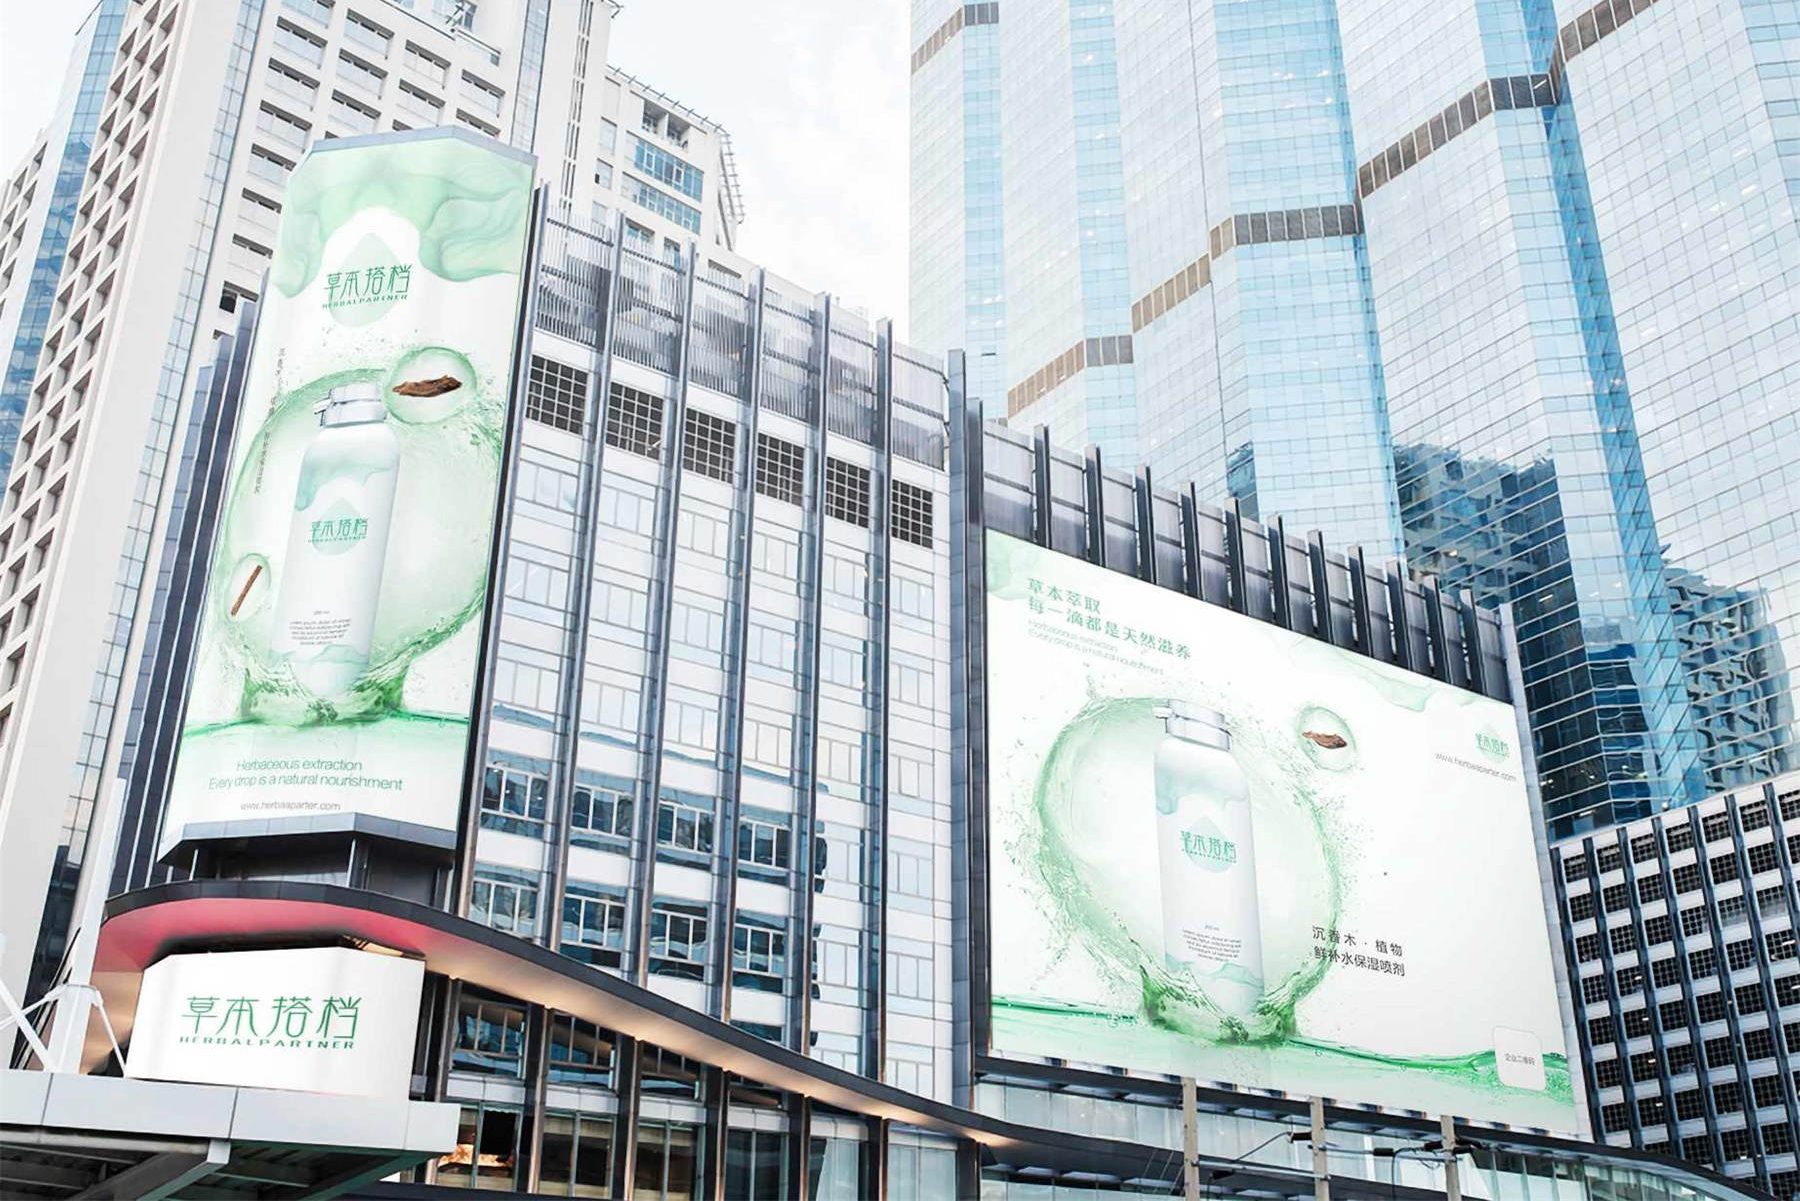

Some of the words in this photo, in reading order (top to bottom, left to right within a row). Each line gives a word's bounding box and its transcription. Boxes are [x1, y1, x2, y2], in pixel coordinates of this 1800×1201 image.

[323, 264, 412, 300] 草本搭档
[1029, 596, 1191, 660] 每一滴都是天然滋养
[302, 759, 362, 771] extraction
[279, 773, 318, 786] natural
[320, 774, 403, 791] nourishment
[1314, 945, 1405, 977] 鲜补水保湿喷剂
[181, 996, 362, 1040] 草本搭档
[179, 1035, 354, 1049] HERBALPARTNER
